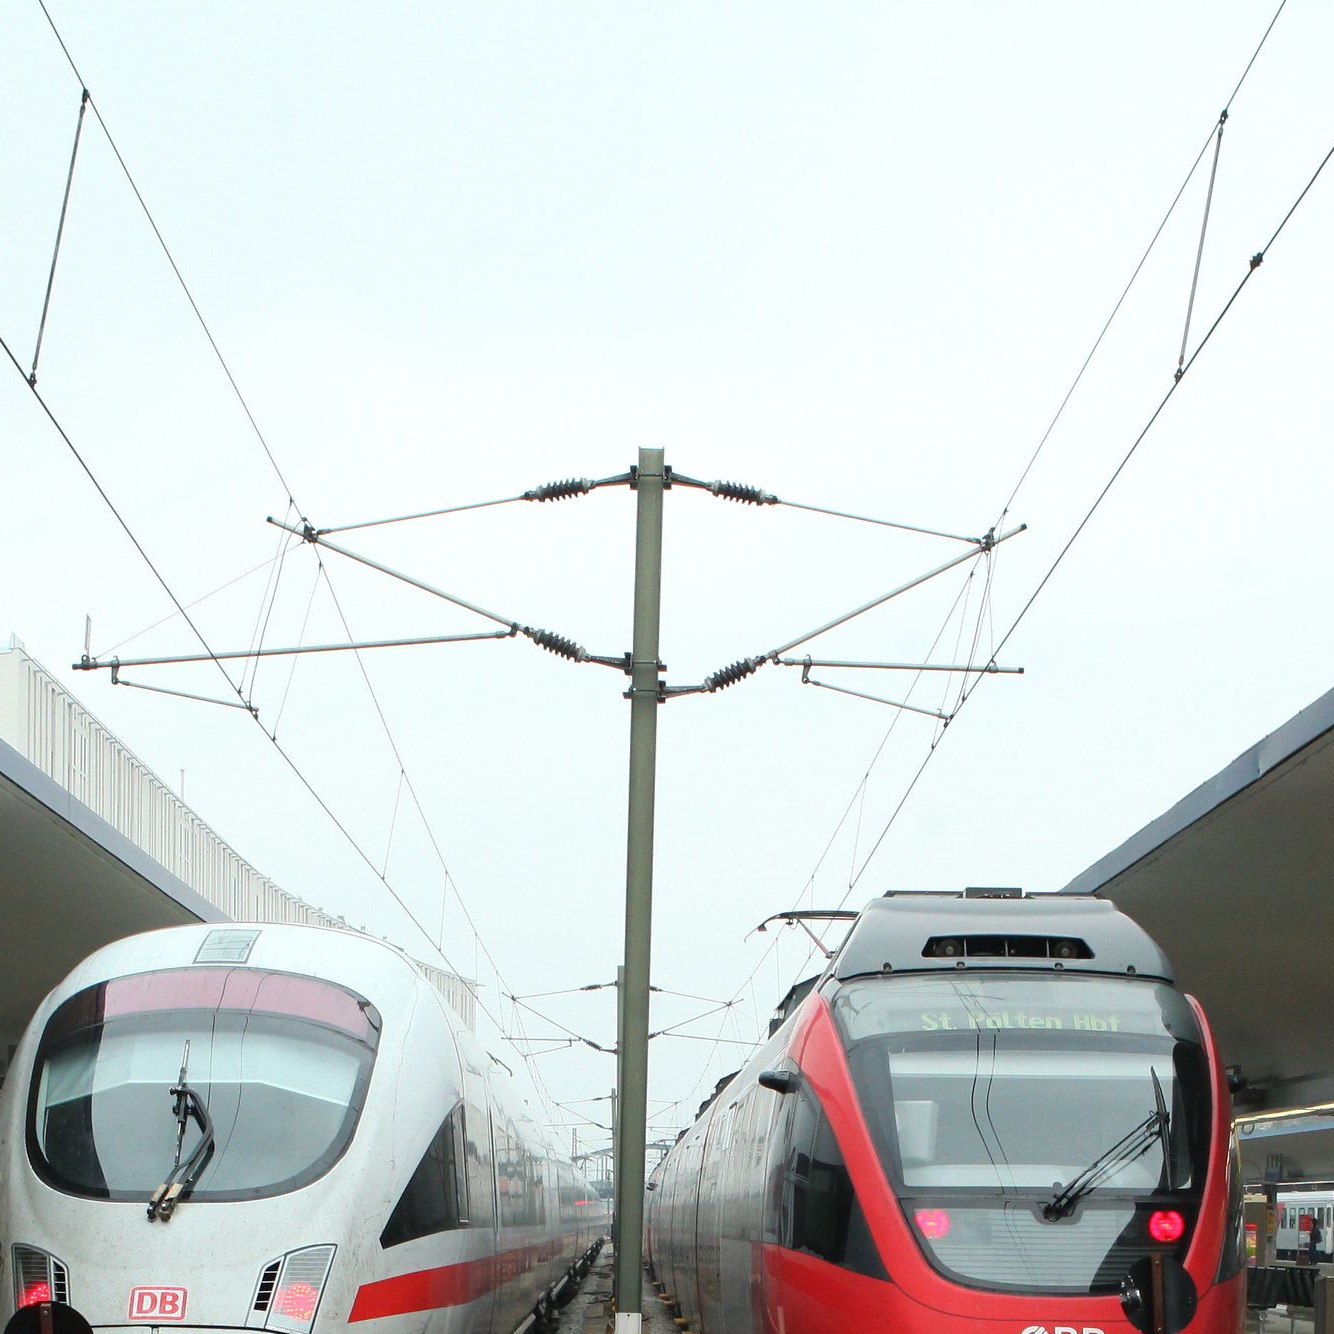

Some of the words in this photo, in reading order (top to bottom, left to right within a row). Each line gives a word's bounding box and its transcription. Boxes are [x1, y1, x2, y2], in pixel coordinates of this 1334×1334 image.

[920, 1011, 957, 1030] St.
[1073, 1012, 1121, 1032] Hbf
[136, 1291, 180, 1315] DB
